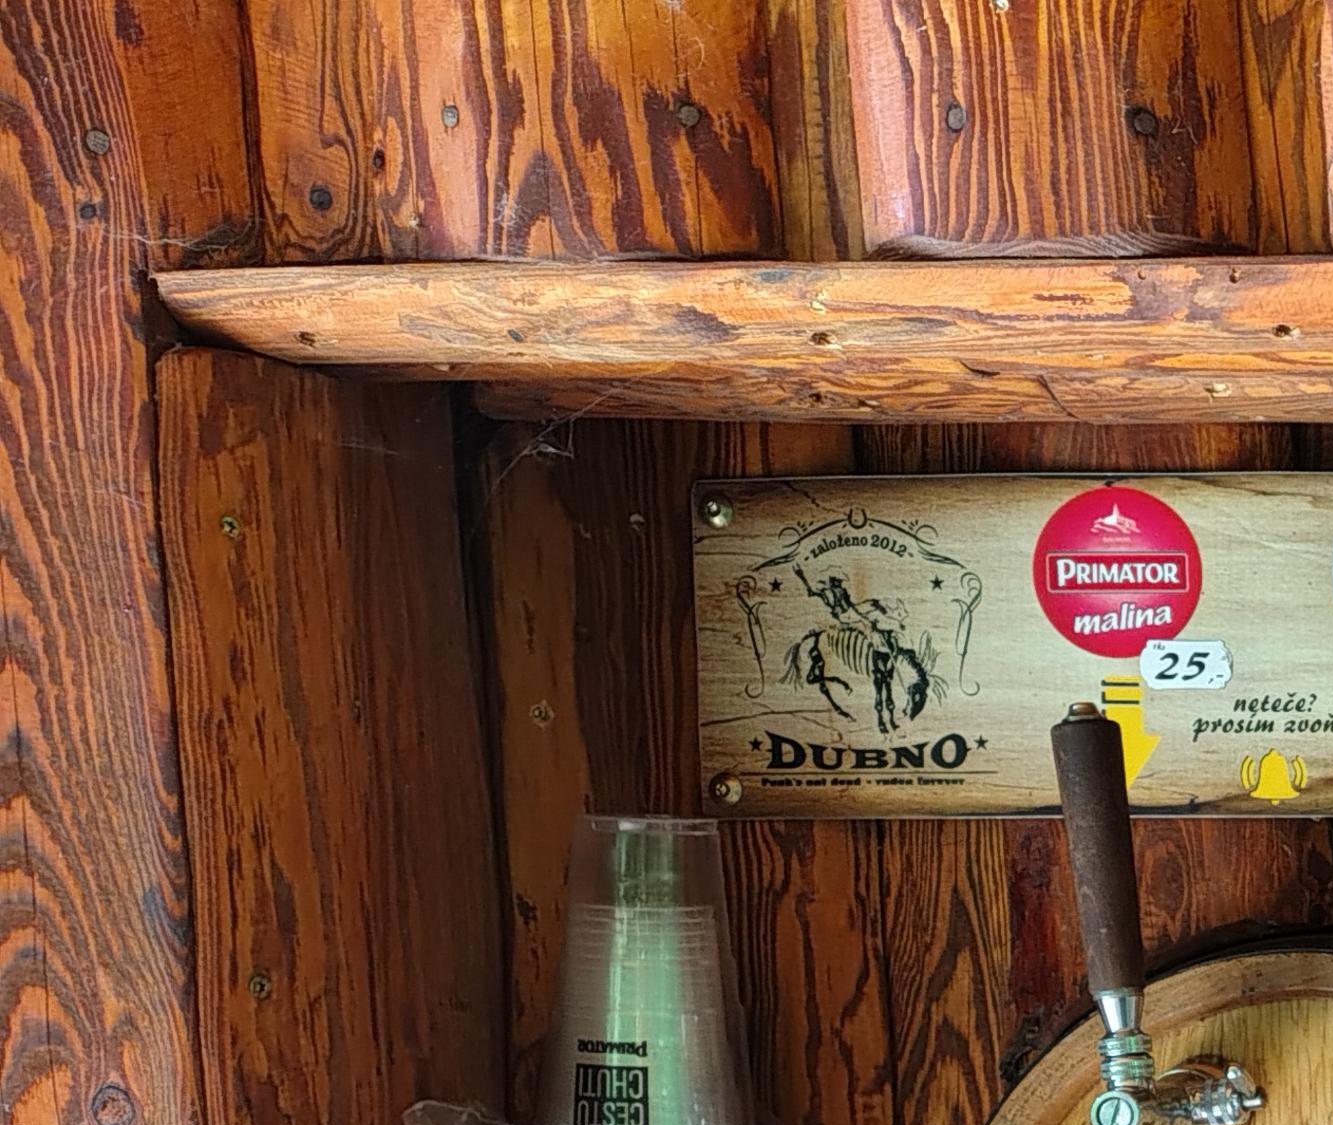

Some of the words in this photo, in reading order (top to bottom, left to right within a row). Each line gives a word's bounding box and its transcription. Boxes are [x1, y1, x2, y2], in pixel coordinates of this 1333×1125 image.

[870, 534, 908, 558] 2012
[1073, 603, 1173, 635] malina
[1233, 692, 1318, 713] neteče?
[1192, 713, 1275, 742] prosím
[764, 729, 973, 770] DUBNO
[578, 1067, 644, 1099] CHUTI
